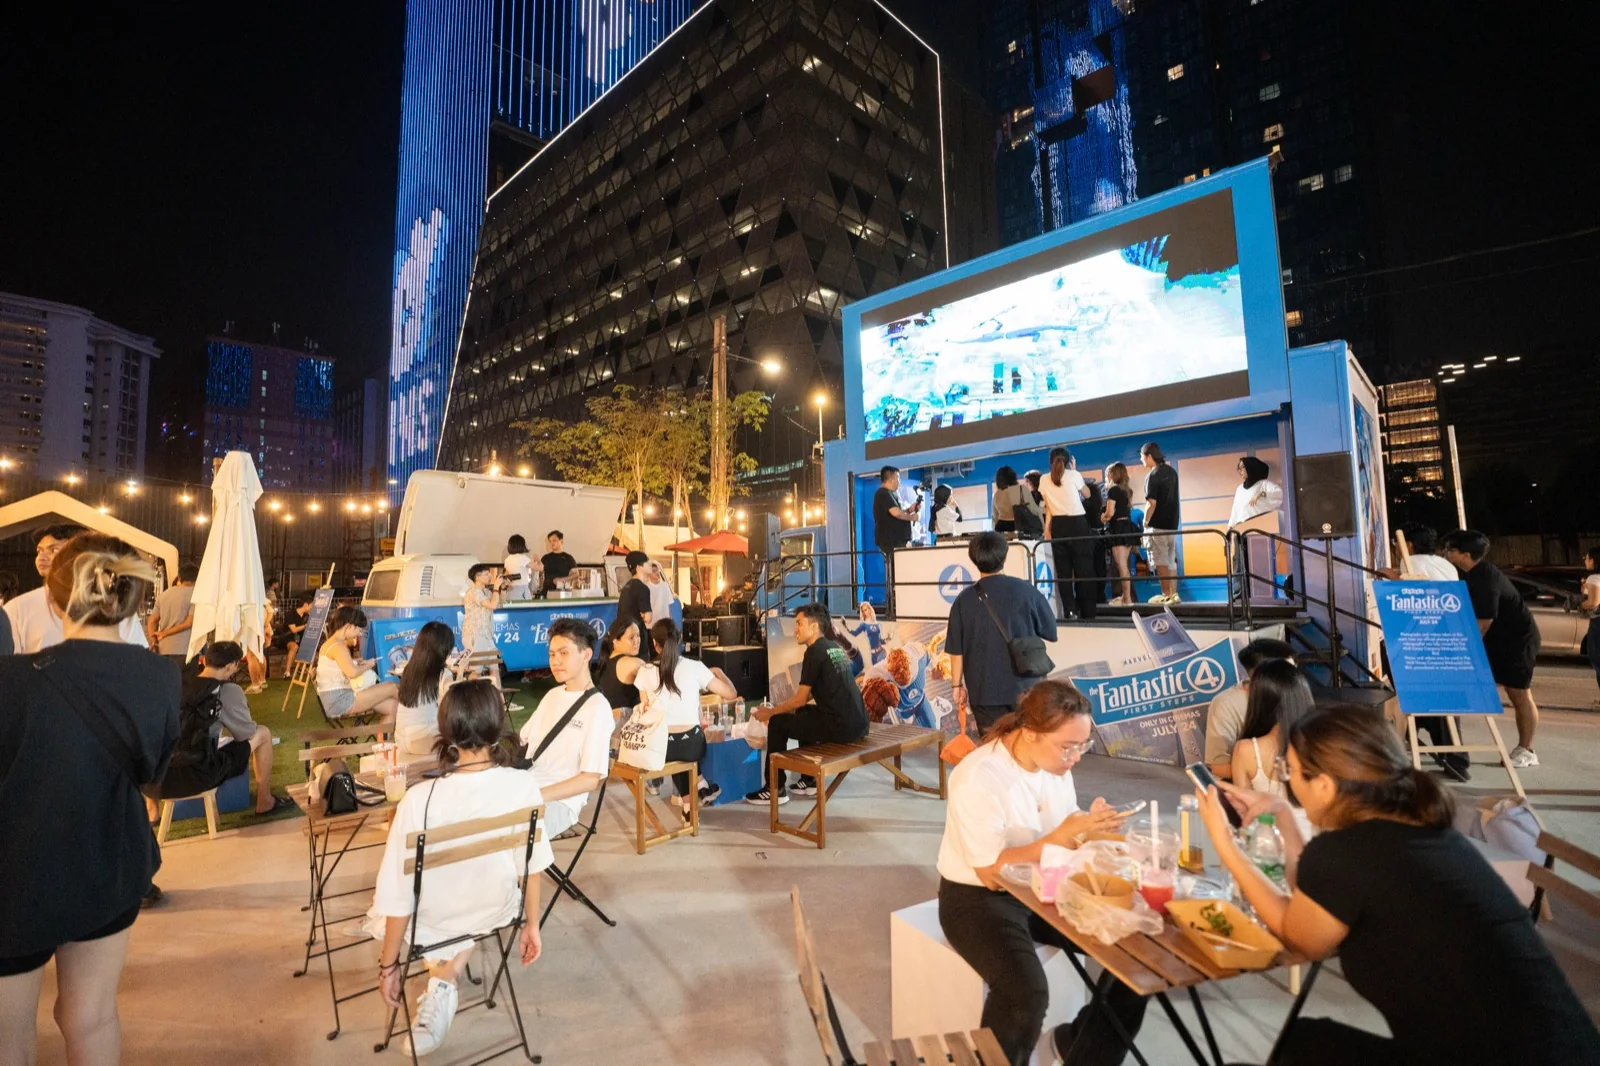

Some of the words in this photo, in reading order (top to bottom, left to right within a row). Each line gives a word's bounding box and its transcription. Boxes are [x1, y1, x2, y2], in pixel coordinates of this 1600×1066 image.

[1391, 594, 1441, 611] Fantastic
[504, 632, 520, 643] 24
[1123, 654, 1153, 666] MARVEL
[1089, 686, 1099, 696] the
[1098, 668, 1188, 714] Fantastic
[1124, 704, 1154, 715] FIRST
[1160, 695, 1196, 707] STEPS
[1139, 718, 1158, 728] ONLY
[1168, 710, 1201, 723] CINEMAS
[1151, 723, 1178, 738] JULY
[1181, 720, 1197, 731] 24
